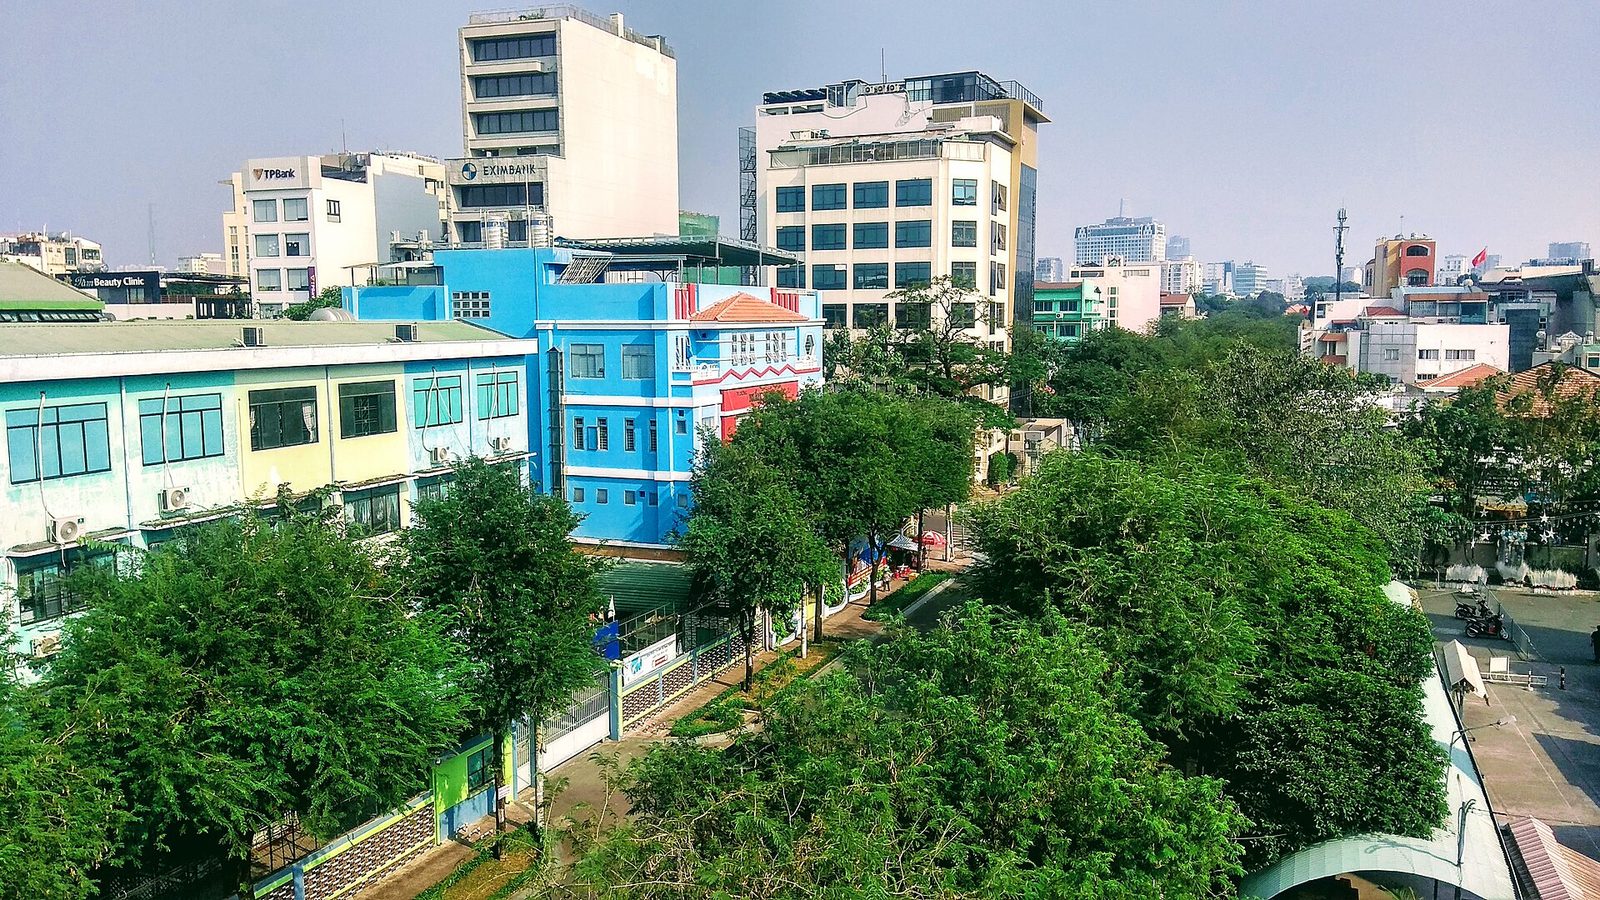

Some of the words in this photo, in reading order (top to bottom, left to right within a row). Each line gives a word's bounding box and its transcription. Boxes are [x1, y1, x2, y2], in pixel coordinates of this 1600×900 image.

[264, 168, 295, 179] TPBank
[483, 164, 536, 176] EXIMBANK
[93, 278, 122, 288] Beauty
[123, 277, 145, 286] Clinic
